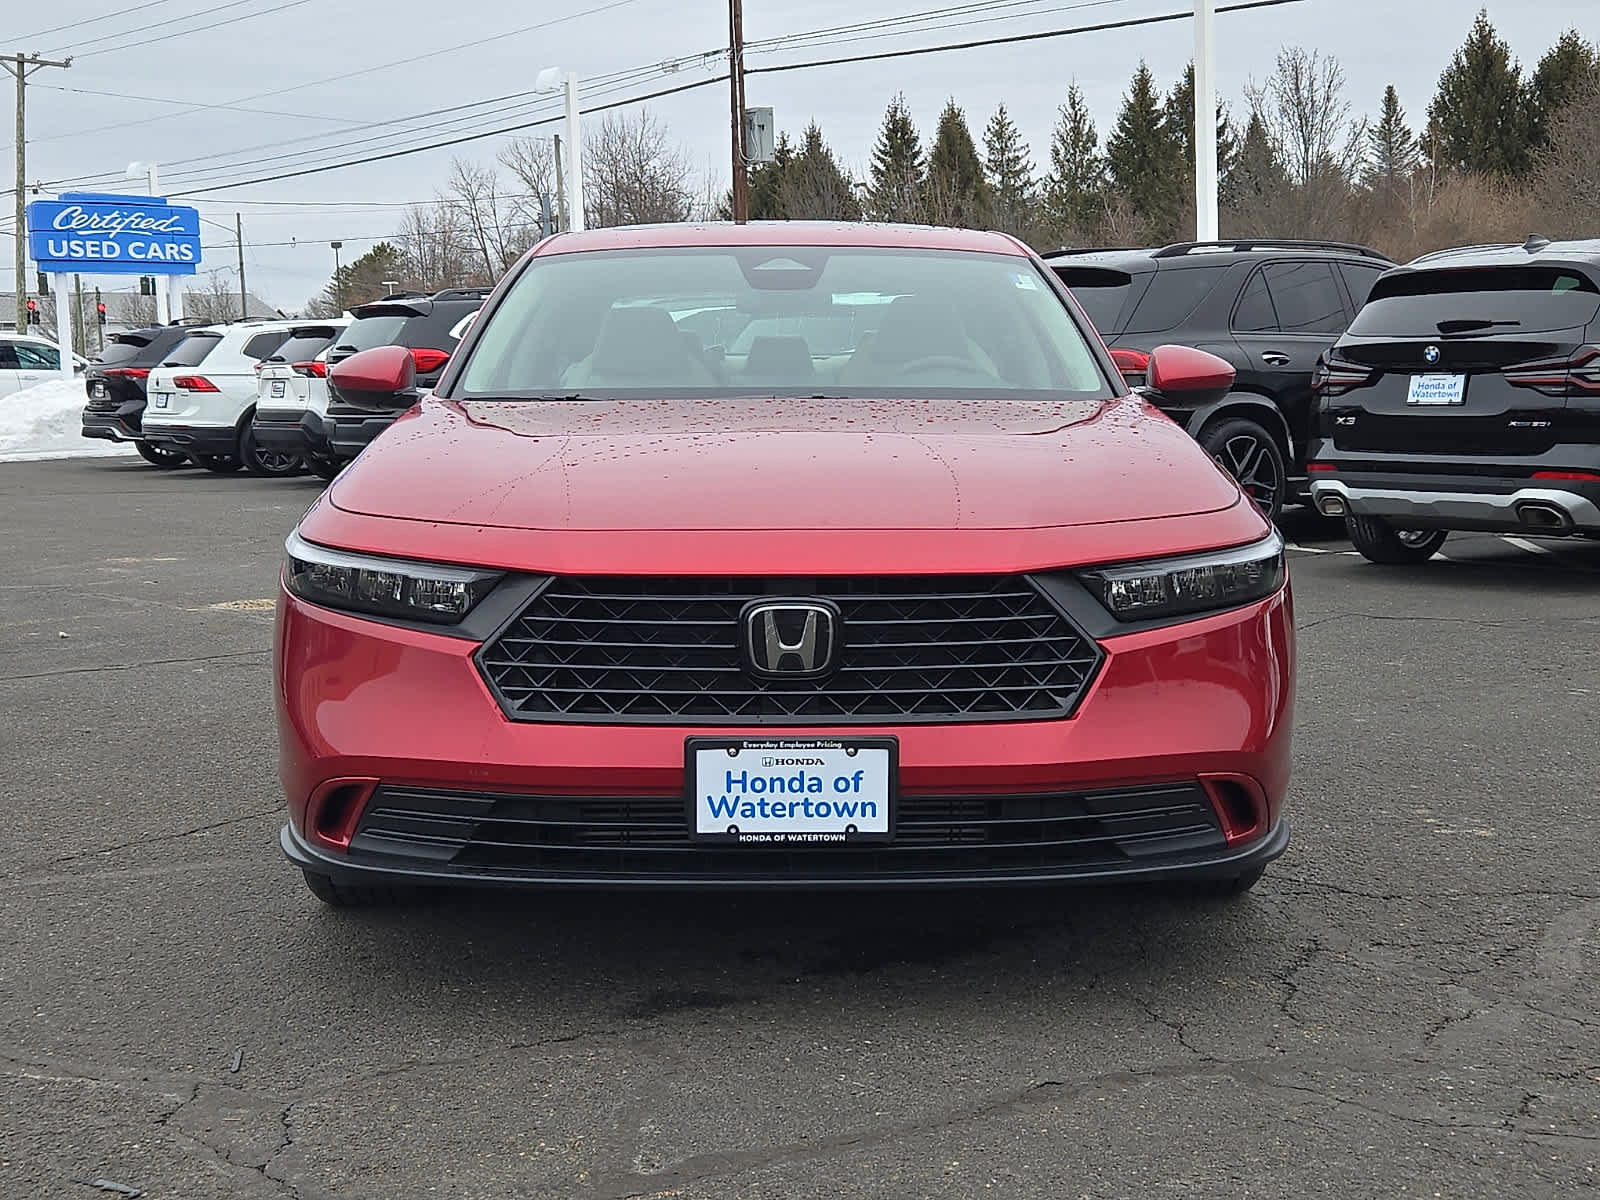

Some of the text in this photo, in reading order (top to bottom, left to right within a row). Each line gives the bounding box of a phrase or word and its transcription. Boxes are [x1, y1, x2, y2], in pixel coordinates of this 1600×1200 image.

[53, 206, 185, 239] Certified
[48, 239, 193, 261] USED CARS
[1417, 381, 1457, 390] Honda of
[1411, 390, 1460, 398] Watertown
[1335, 416, 1356, 425] X3
[742, 741, 843, 750] Everyday Employee Pricing
[775, 758, 825, 766] HONDA
[725, 770, 865, 794] Honda of
[706, 795, 878, 819] Watertown
[739, 834, 846, 842] HONDA OF WATERTOWN
